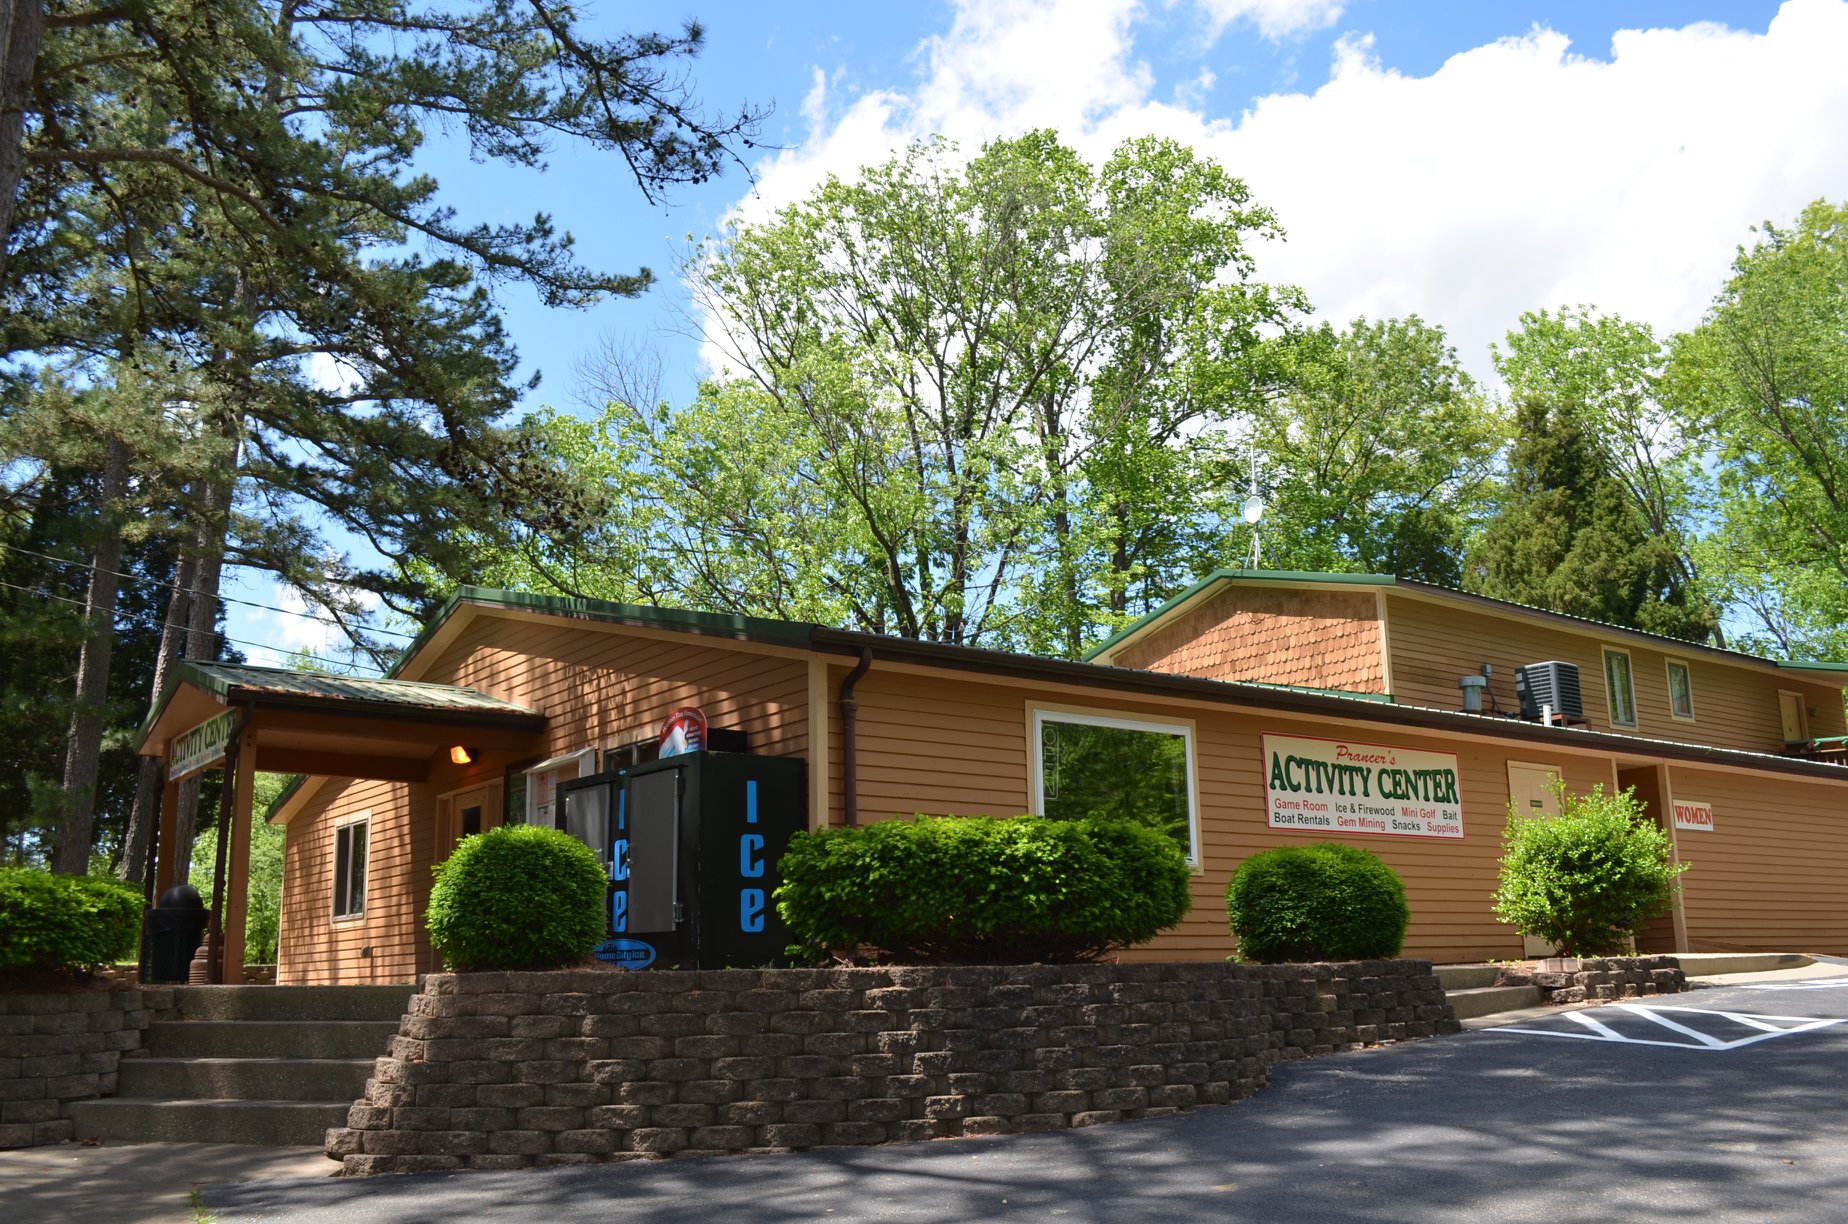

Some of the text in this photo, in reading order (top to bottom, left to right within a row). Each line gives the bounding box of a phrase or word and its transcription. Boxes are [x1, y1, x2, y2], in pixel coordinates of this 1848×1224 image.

[171, 725, 204, 767] ACTIVITY
[1335, 744, 1397, 766] Prancer's
[1043, 728, 1056, 796] OPEN
[1269, 751, 1459, 804] ACTIVITY CENTER
[1274, 797, 1458, 820] Game Room Ice & Firewood Mini Golf Bait
[1675, 806, 1712, 825] WOMEN
[1274, 812, 1459, 835] Boat Rentals Gem Mining Snacks Supplies
